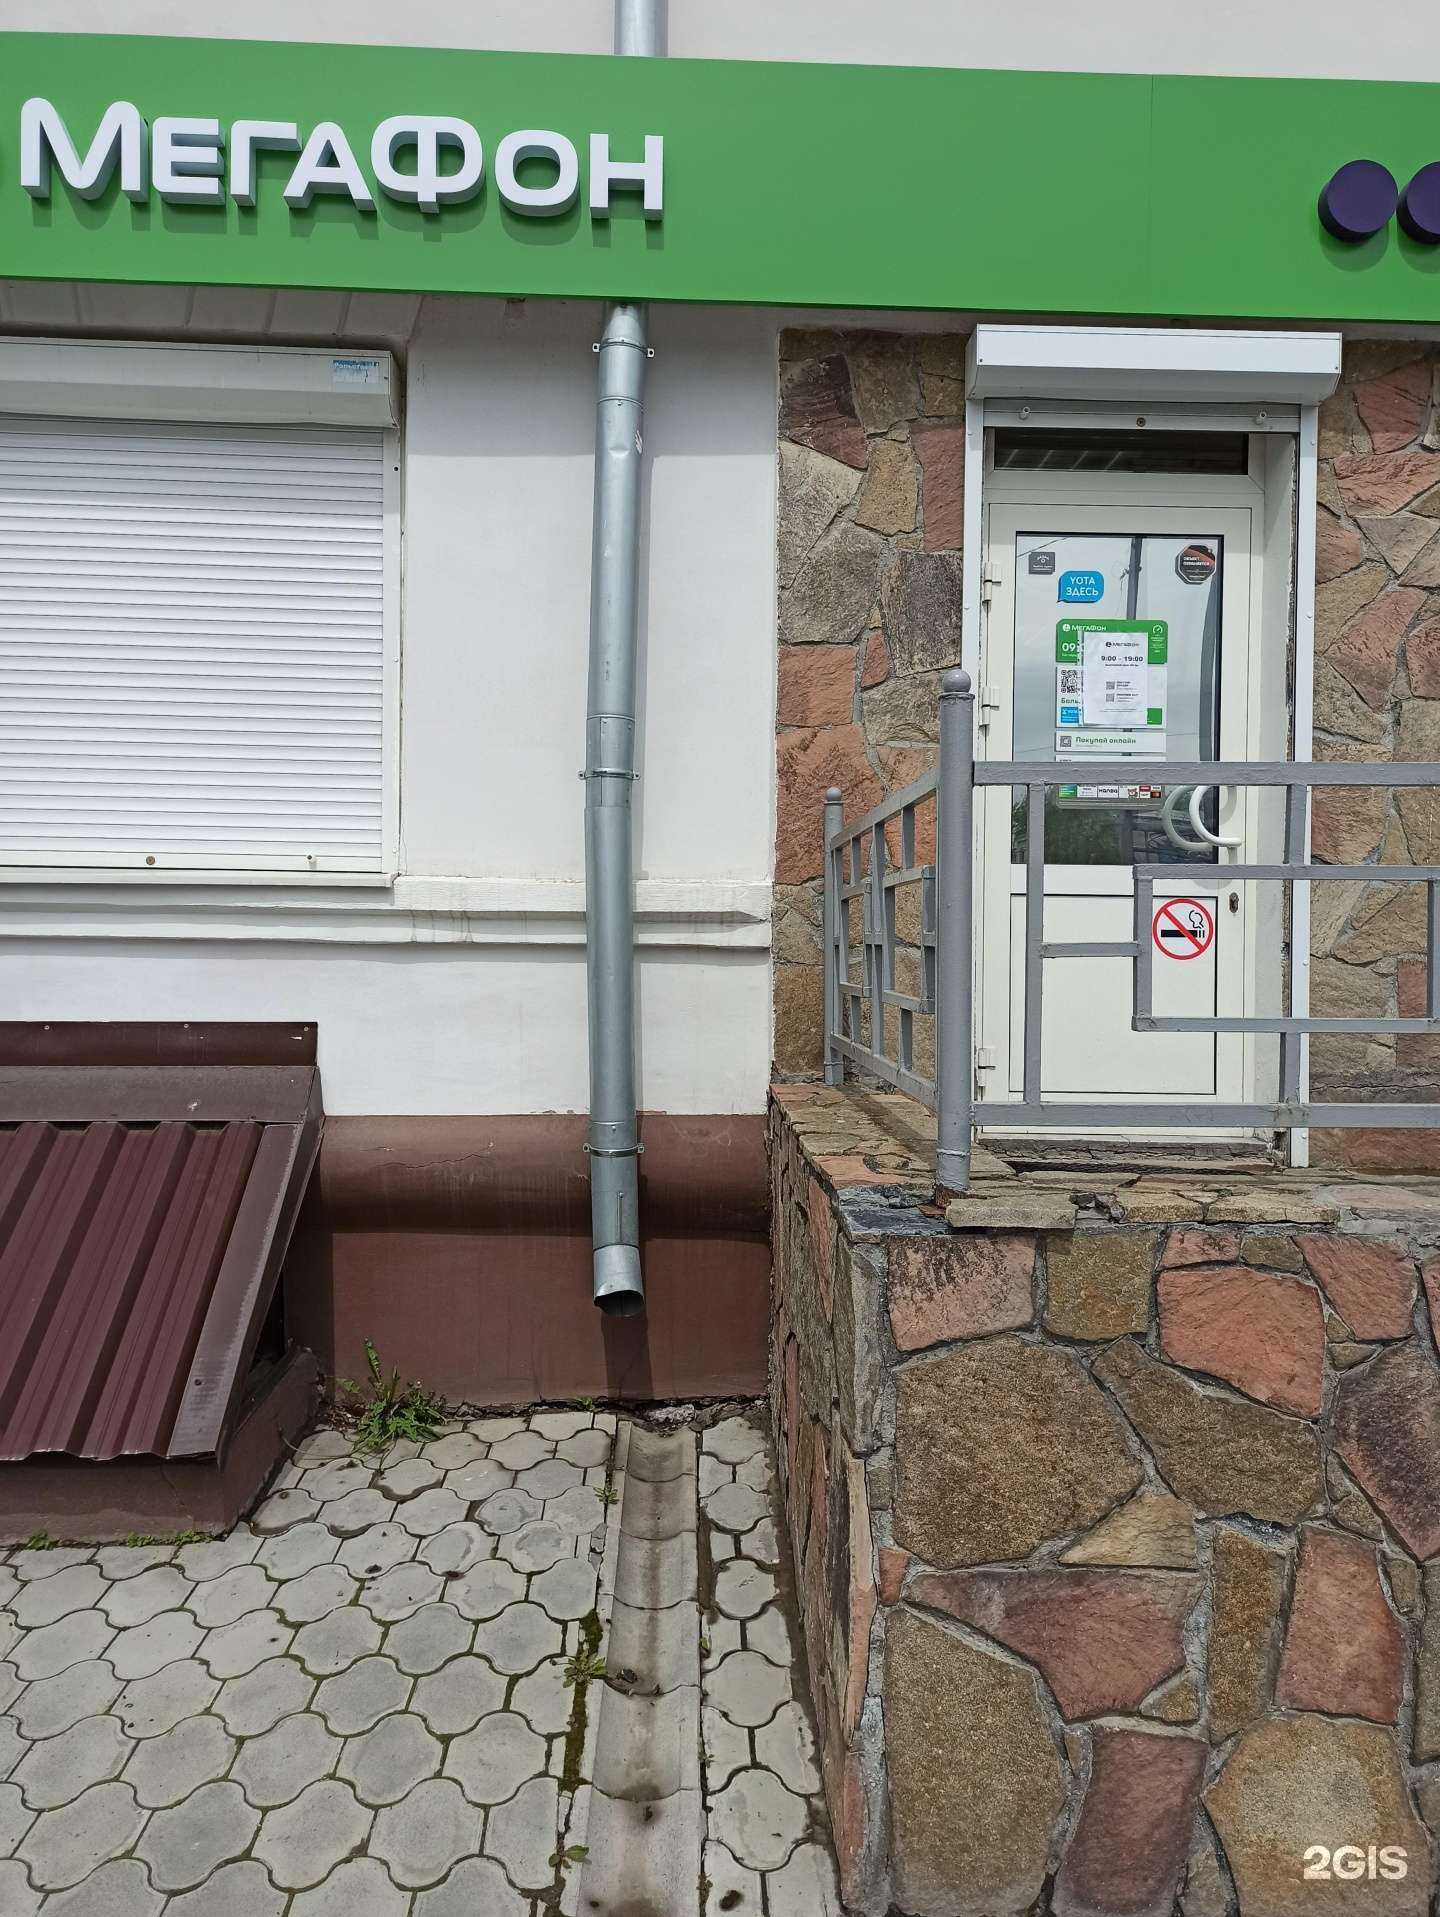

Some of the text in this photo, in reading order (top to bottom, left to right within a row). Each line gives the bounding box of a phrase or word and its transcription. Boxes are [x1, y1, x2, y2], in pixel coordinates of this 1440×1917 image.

[1070, 576, 1096, 585] YOTA
[1065, 586, 1099, 597] ЗДЕСЬ
[1075, 736, 1108, 745] Покупай
